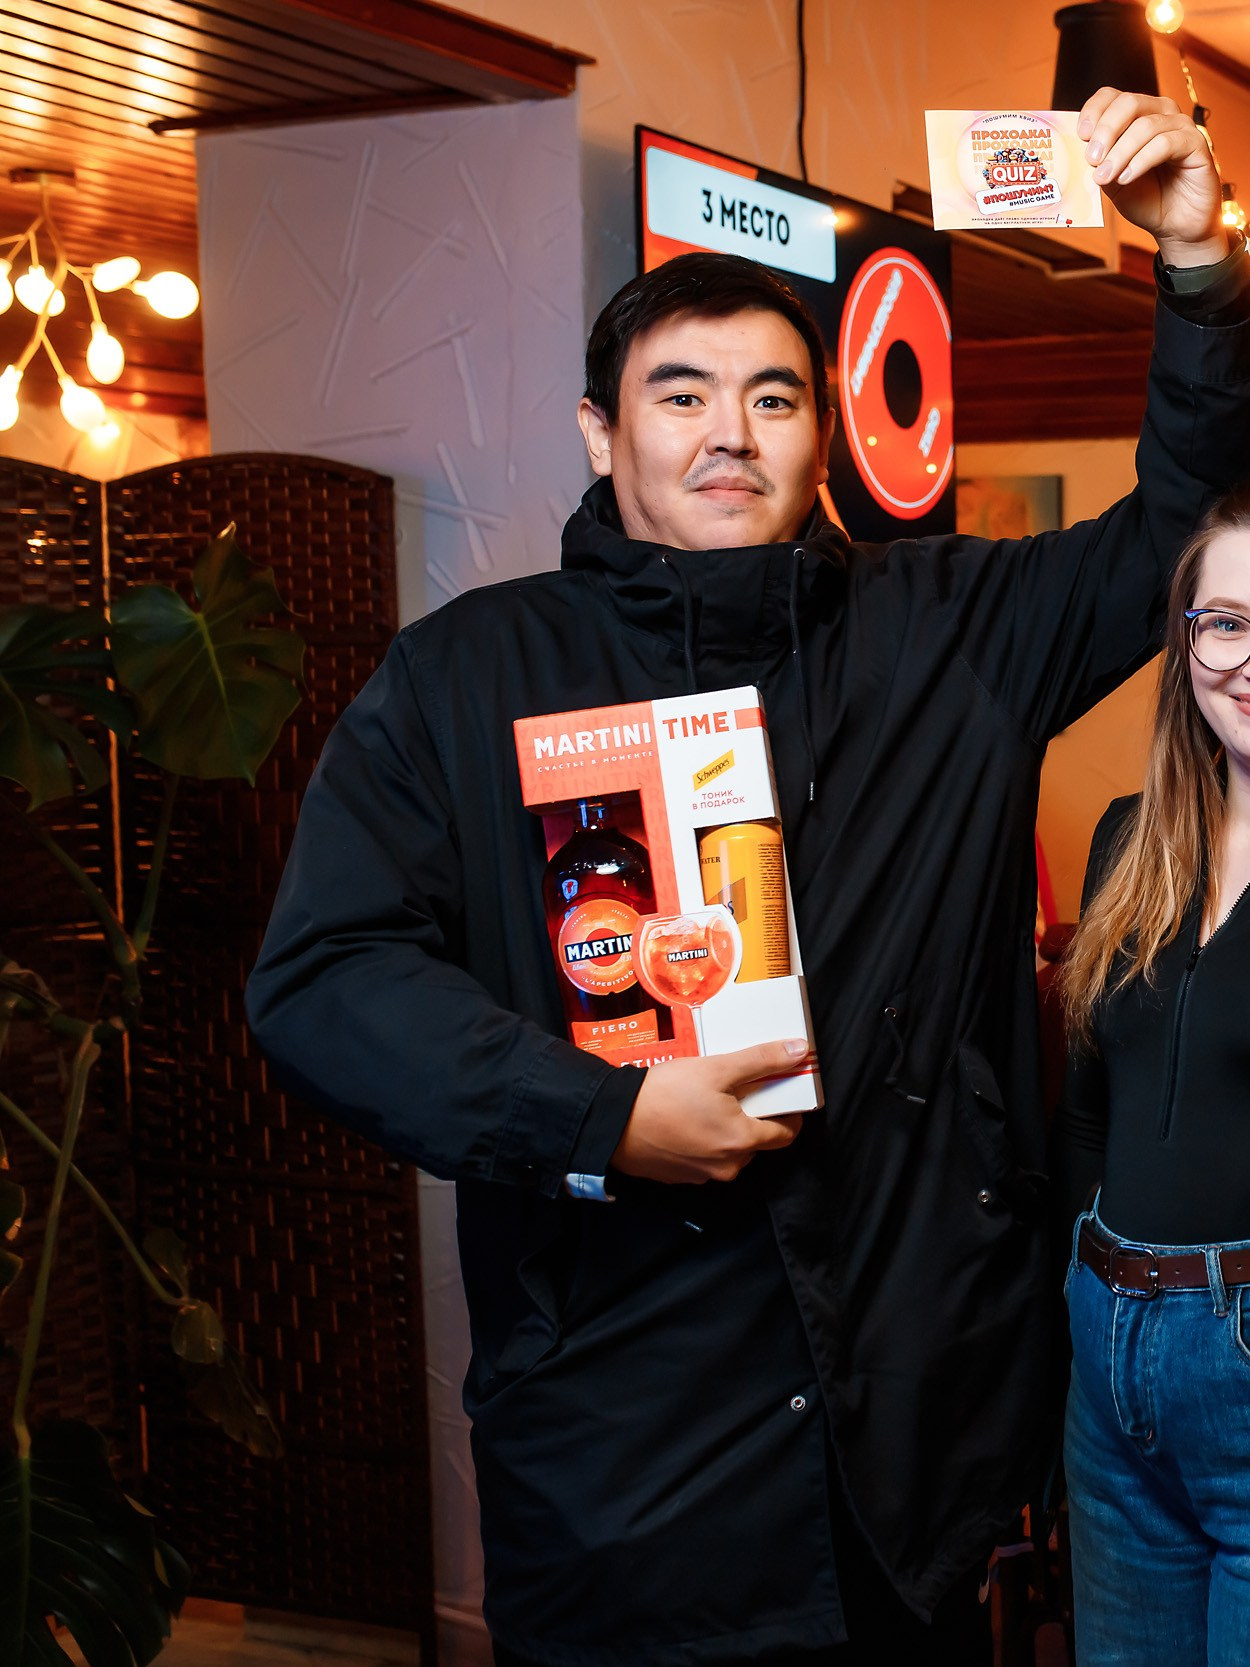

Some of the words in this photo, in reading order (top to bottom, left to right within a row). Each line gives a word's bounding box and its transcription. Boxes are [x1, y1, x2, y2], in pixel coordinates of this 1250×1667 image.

[993, 165, 1037, 182] QUIZ
[1009, 197, 1035, 207] #MUSIC
[1035, 193, 1055, 202] GAME
[702, 189, 713, 223] 3
[720, 194, 790, 246] МЕСТО
[533, 722, 652, 760] MARTINI
[662, 711, 730, 740] TIME
[537, 761, 585, 773] СЧАСТЬЕ
[603, 751, 653, 763] МОМЕНТЕ
[696, 758, 731, 784] Schweppes
[700, 796, 745, 809] ПОДАРОК
[702, 789, 733, 800] ТОНИК
[566, 935, 632, 961] MARTIN
[668, 949, 708, 962] MARTINI
[592, 1021, 638, 1036] FIERO
